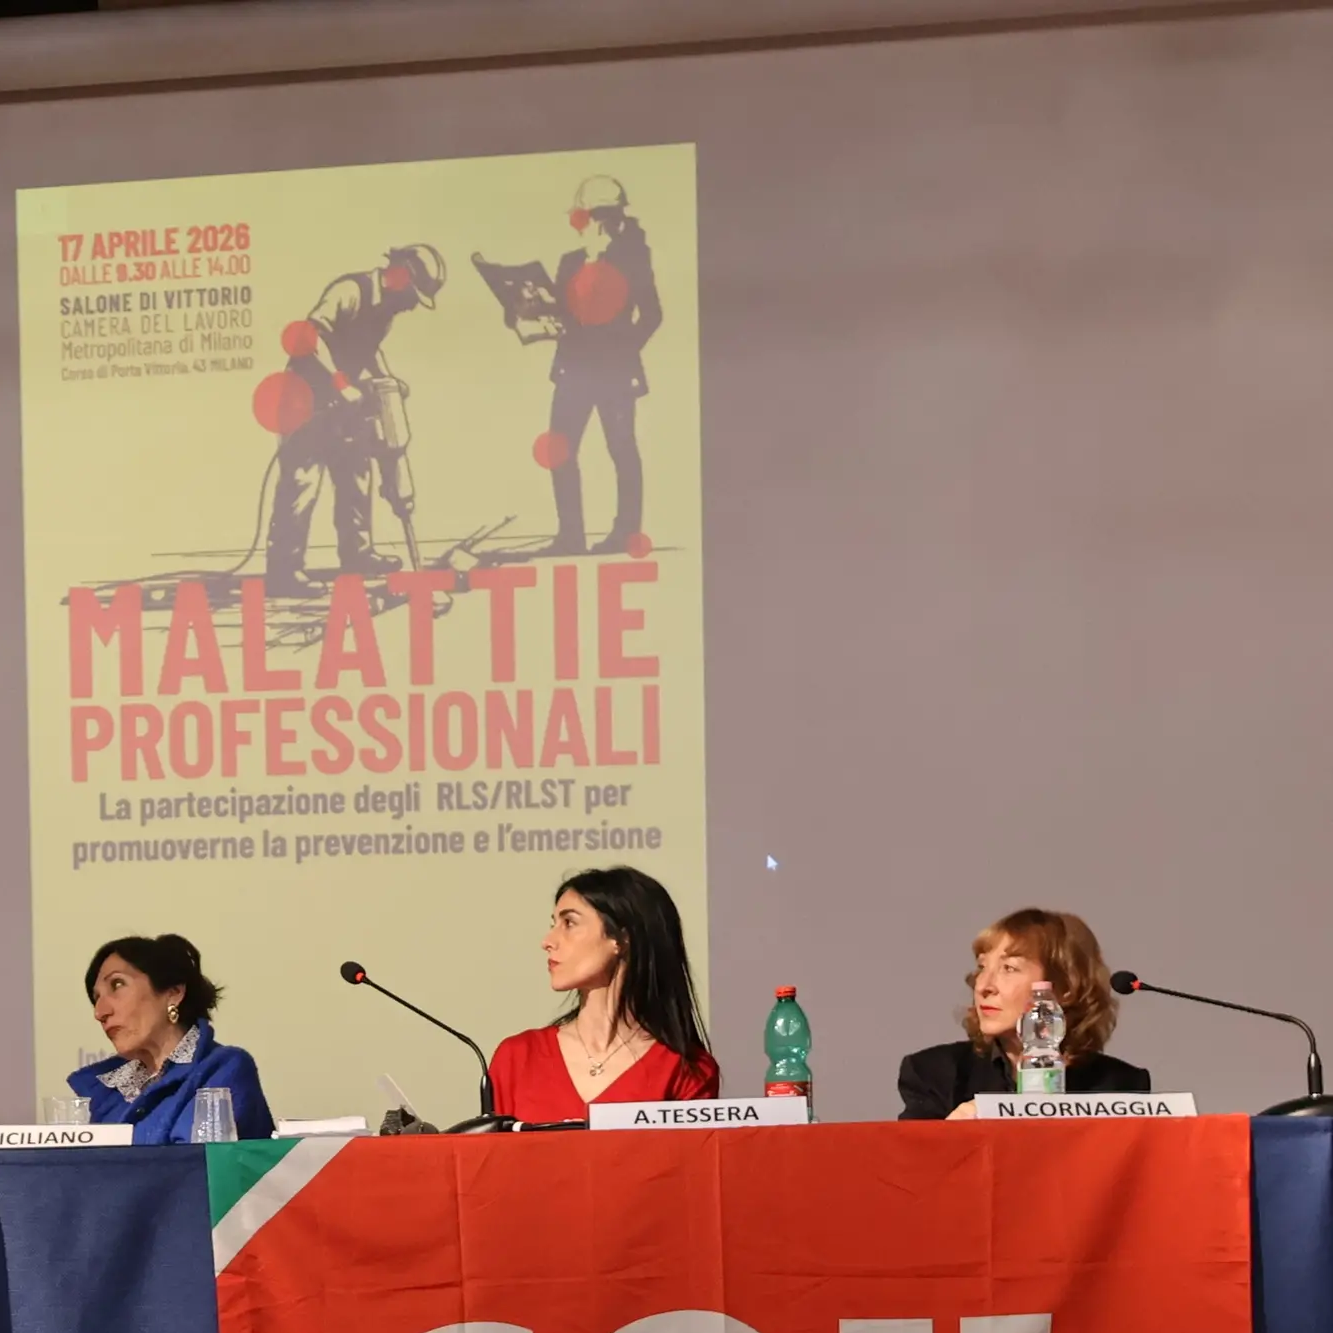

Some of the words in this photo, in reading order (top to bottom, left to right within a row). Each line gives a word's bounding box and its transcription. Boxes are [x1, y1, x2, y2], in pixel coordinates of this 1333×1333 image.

[58, 234, 84, 262] 17
[91, 227, 180, 260] APRILE
[186, 223, 251, 253] 2026
[60, 263, 112, 286] DALLE
[160, 258, 202, 280] ALLE
[207, 254, 251, 276] 14.00
[60, 293, 132, 315] SALONE
[140, 292, 157, 311] DI
[164, 286, 252, 309] VITTORIO
[61, 316, 131, 339] CAMERA
[141, 313, 174, 335] DEL
[184, 308, 252, 331] LAVORO
[61, 337, 173, 362] Metropolitana
[179, 333, 194, 353] di
[200, 332, 253, 352] Milano
[67, 562, 660, 699] MALATTIE
[70, 684, 661, 782] PROFESSIONALI
[99, 791, 131, 821] La
[139, 783, 345, 826] partecipazione
[353, 782, 420, 820] degli
[436, 777, 575, 811] RLS/RLST
[584, 780, 632, 814] per
[73, 830, 255, 870] promuoverne
[263, 829, 287, 858] la
[294, 824, 464, 864] prevenzione
[473, 827, 489, 853] e
[497, 820, 662, 852] l’emersione
[634, 1105, 760, 1124] A.TESSERA
[998, 1101, 1172, 1117] N.CORNAGGIA
